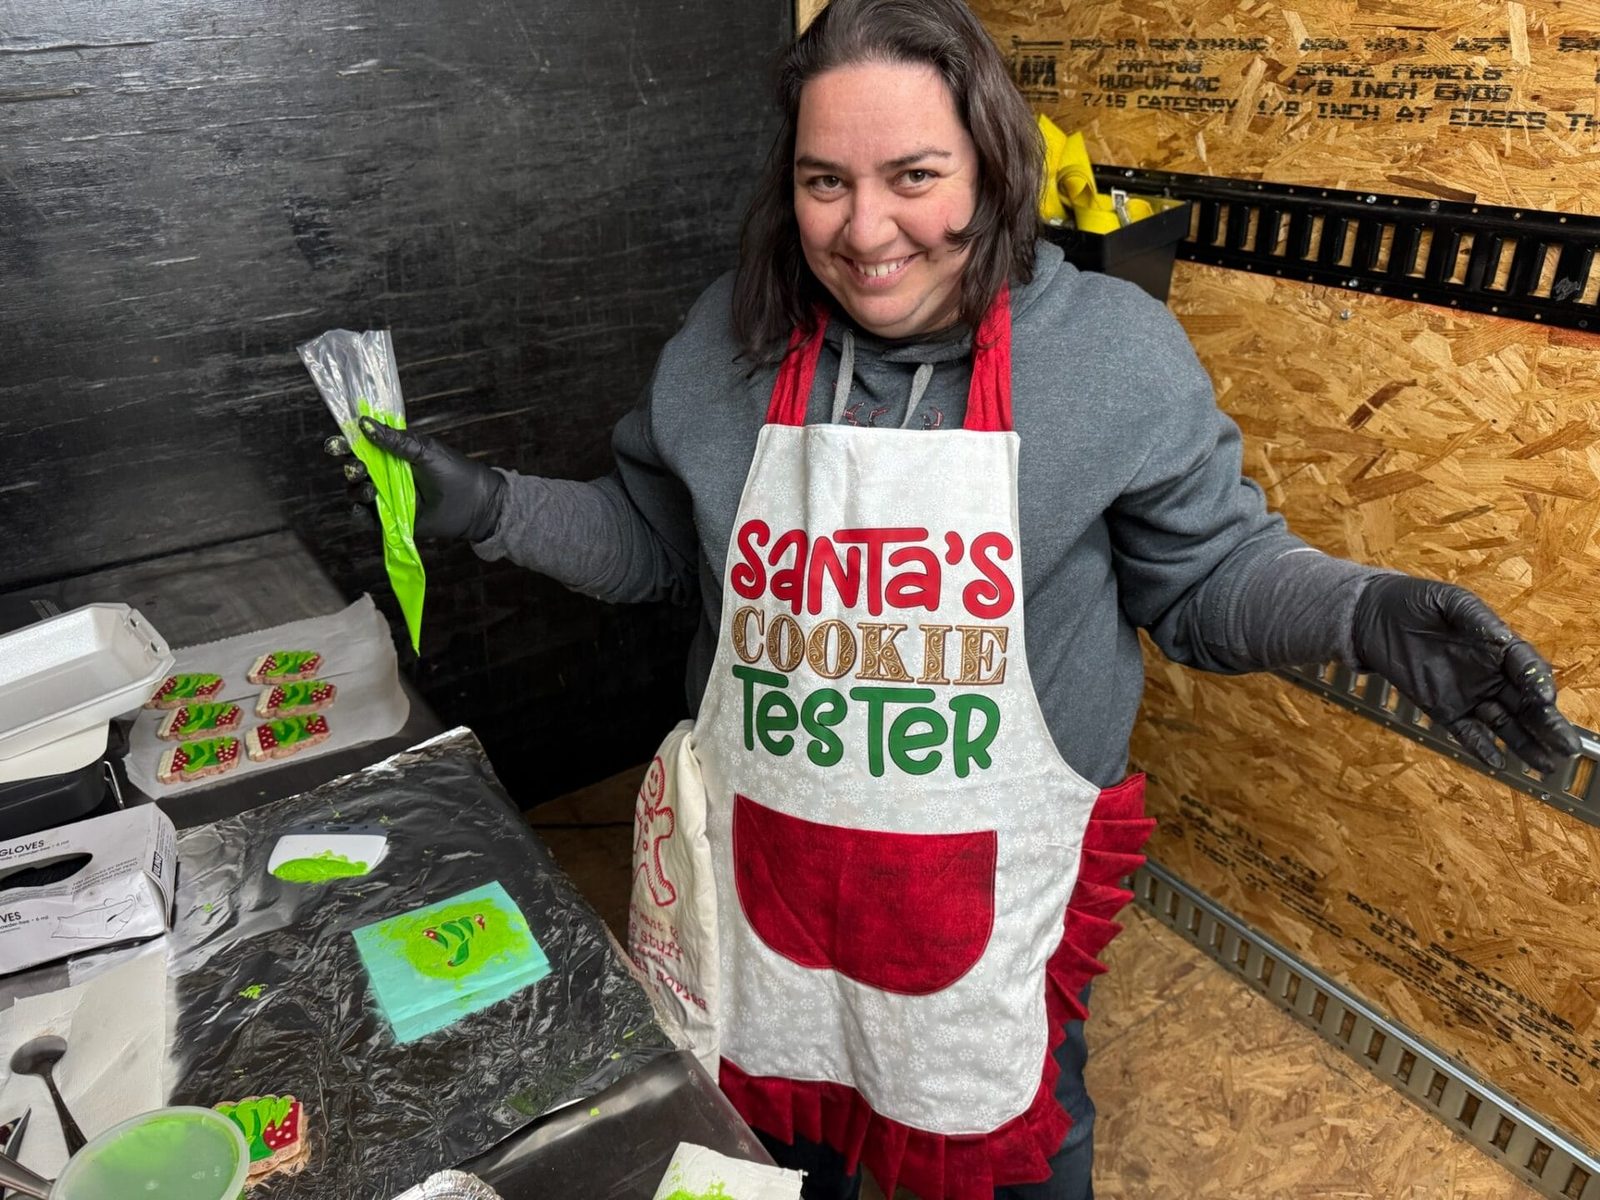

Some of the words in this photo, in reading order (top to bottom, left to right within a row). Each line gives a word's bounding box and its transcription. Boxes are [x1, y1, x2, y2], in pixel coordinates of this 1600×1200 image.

[1350, 80, 1418, 99] INCH
[1317, 102, 1380, 121] INCH
[1396, 106, 1433, 124] AT
[1565, 112, 1600, 132] TH
[731, 605, 1009, 685] COOKIE
[0, 839, 45, 857] GLOVES
[0, 911, 22, 924] VES
[641, 931, 685, 963] stuff
